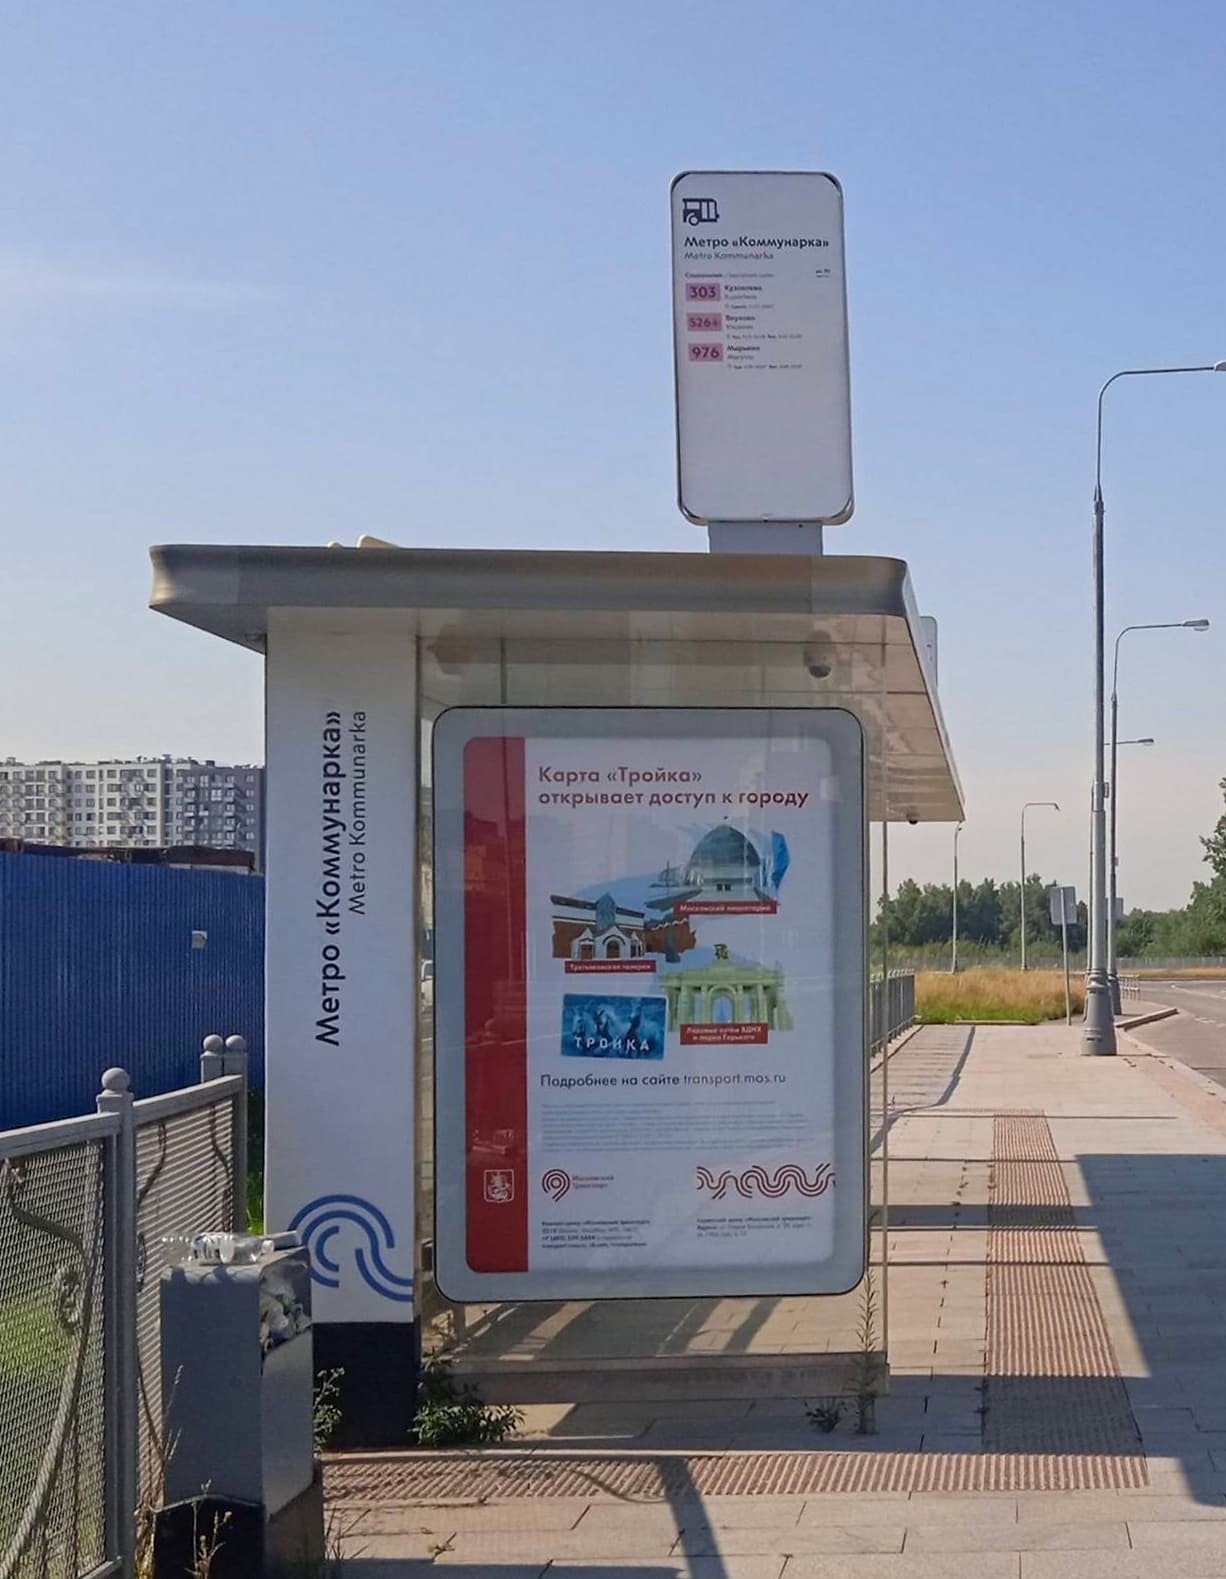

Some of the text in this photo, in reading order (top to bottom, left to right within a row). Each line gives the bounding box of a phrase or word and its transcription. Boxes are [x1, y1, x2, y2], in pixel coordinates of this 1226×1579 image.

[684, 236, 829, 249] Метро «Коммунарка»
[684, 252, 774, 260] Metro Kommunarka
[690, 286, 717, 299] 303
[691, 347, 720, 359] 976
[538, 766, 702, 787] Карта «Тройка»
[538, 791, 809, 808] открывает доступ к городу
[348, 710, 367, 915] Metro Kommunarka
[315, 711, 347, 1047] Метро «Коммунарка»
[539, 1073, 618, 1089] Подробнее
[621, 1075, 638, 1086] на
[641, 1073, 680, 1087] сайте
